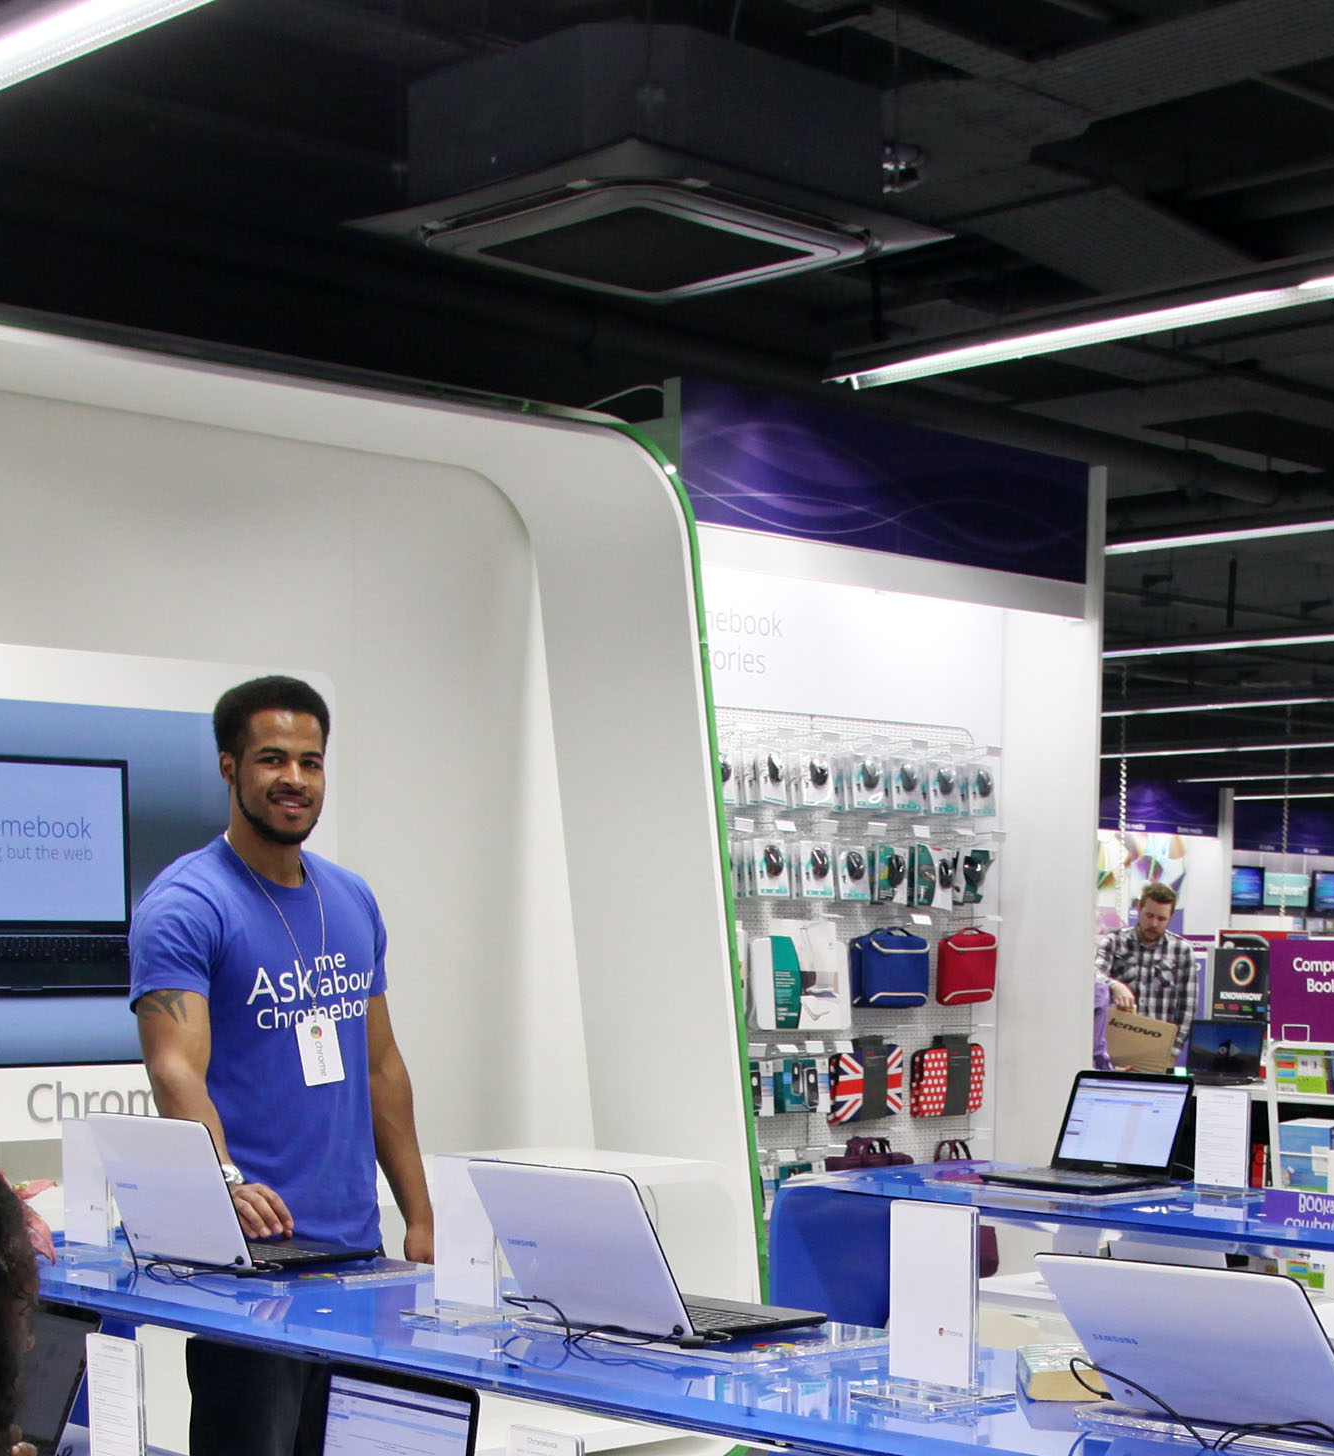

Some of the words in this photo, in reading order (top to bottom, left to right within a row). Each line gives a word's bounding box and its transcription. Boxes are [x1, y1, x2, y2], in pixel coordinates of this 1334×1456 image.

[712, 645, 766, 674] ories
[6, 844, 31, 860] but
[35, 845, 59, 861] the
[63, 846, 93, 862] web
[314, 952, 347, 972] me
[246, 960, 313, 1006] Ask
[1109, 1018, 1162, 1038] lenovo
[1092, 1333, 1139, 1346] SAMSUNG
